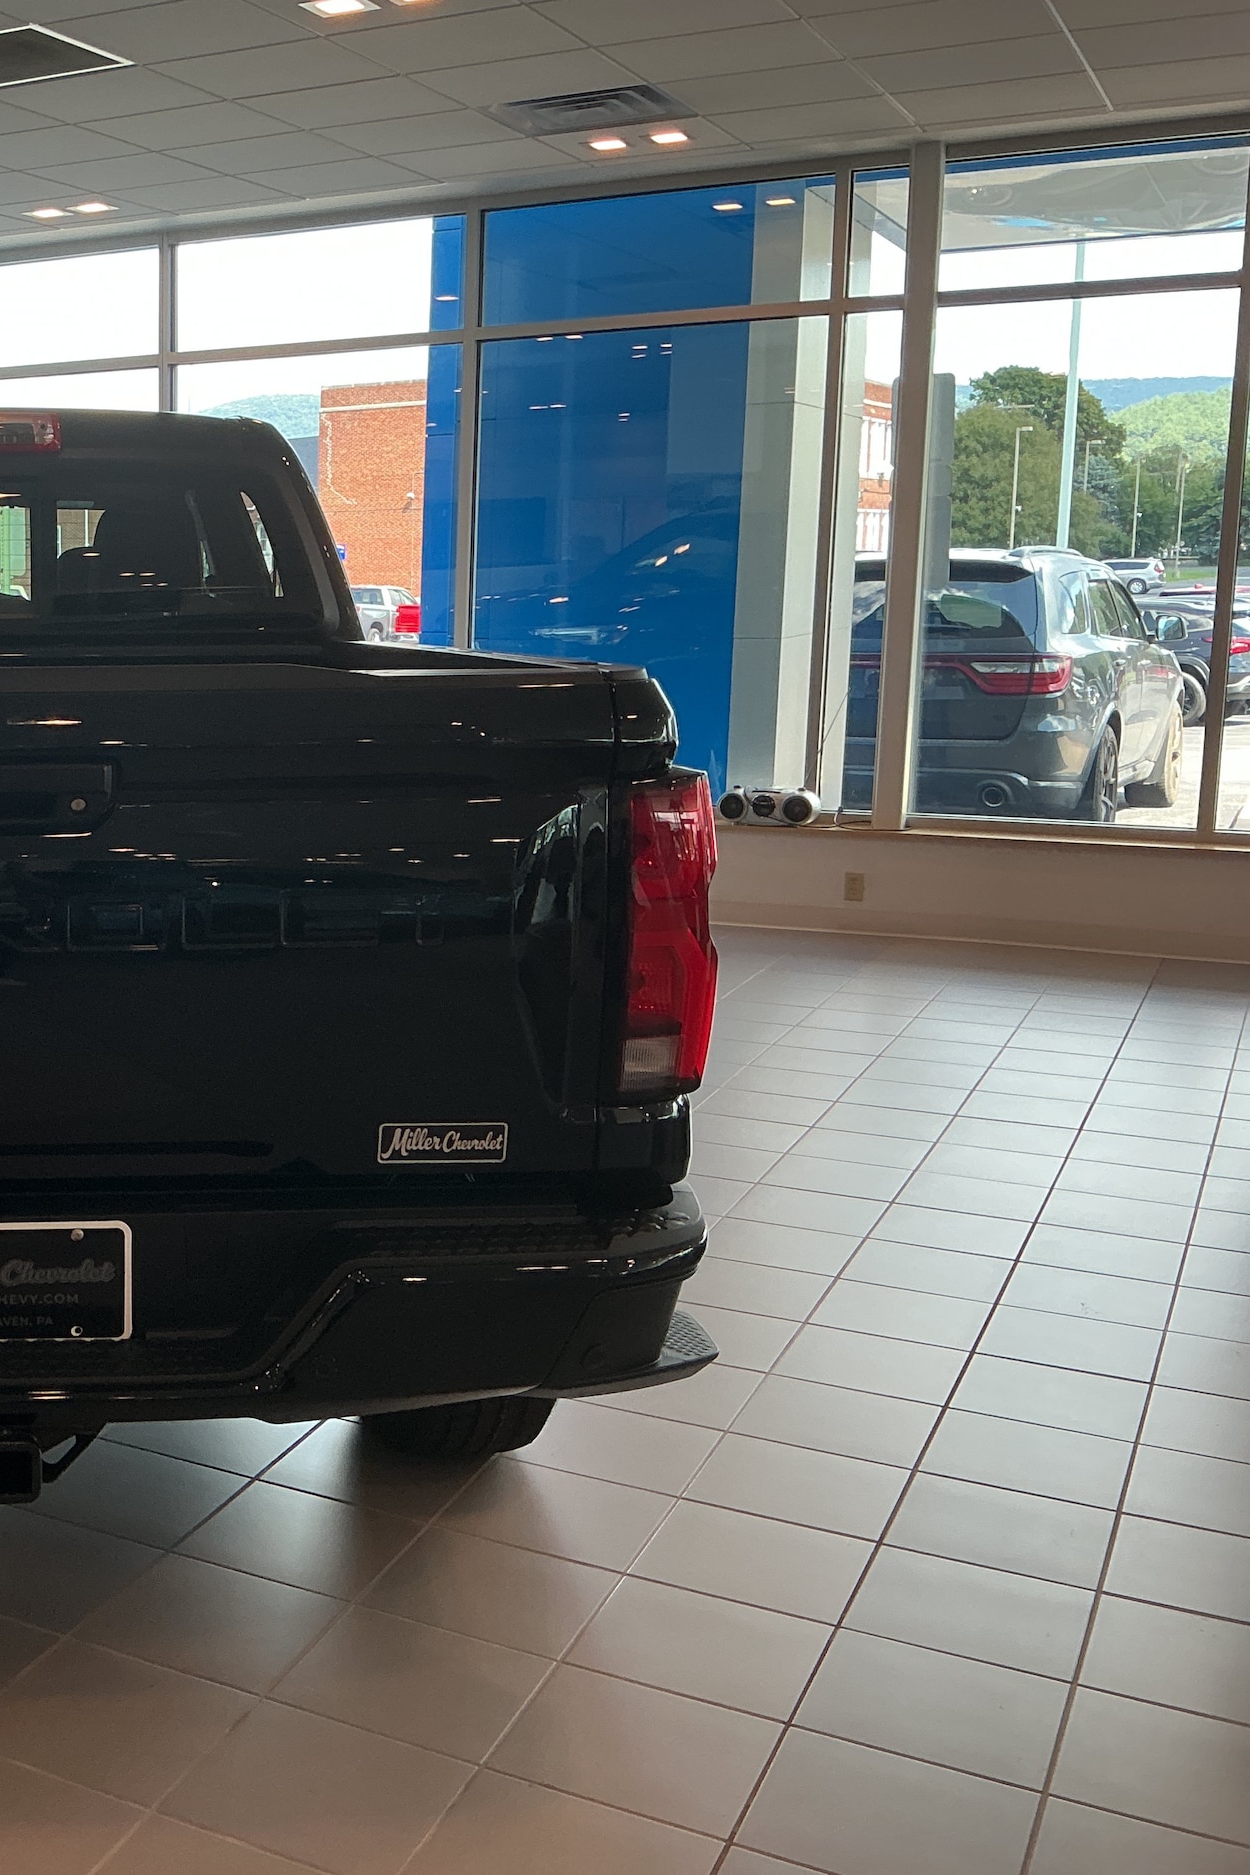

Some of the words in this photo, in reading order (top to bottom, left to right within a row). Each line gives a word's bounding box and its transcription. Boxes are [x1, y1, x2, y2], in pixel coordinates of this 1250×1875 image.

[381, 1127, 442, 1159] Miller
[442, 1129, 504, 1153] Chevrolet
[36, 1316, 54, 1326] PA
